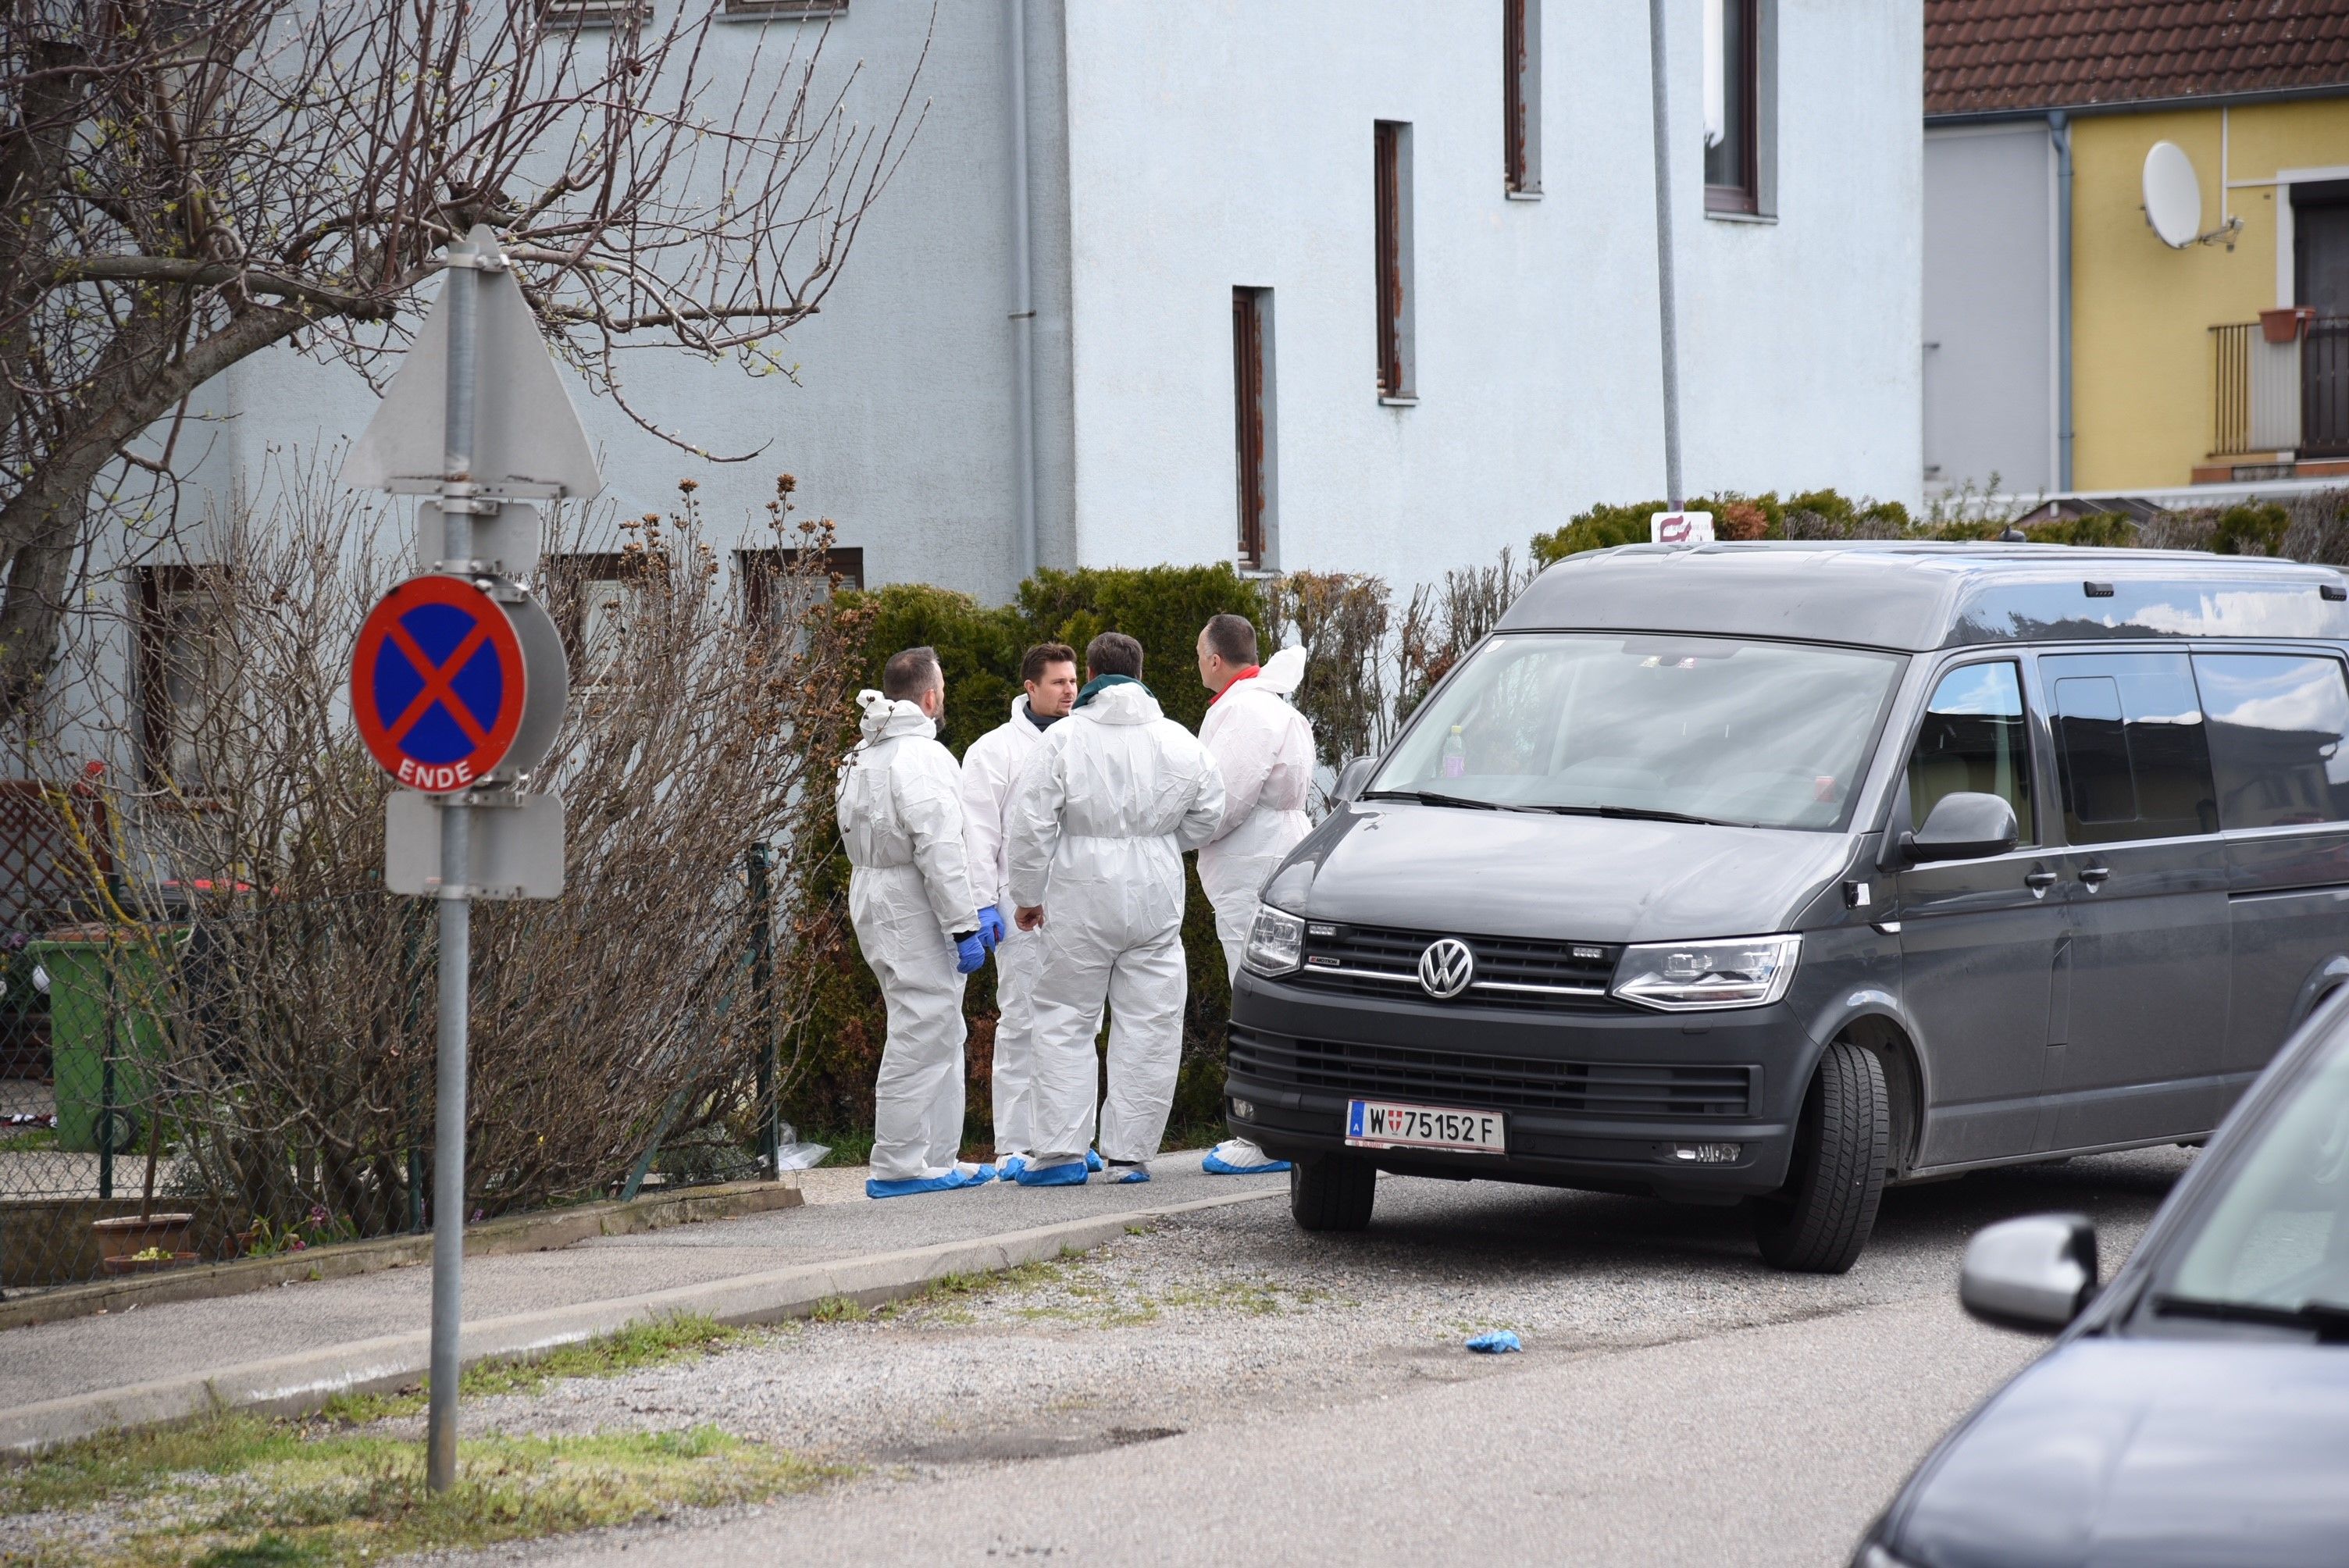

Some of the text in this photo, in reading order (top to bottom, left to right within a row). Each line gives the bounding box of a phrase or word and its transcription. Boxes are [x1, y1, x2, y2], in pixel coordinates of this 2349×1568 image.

[397, 757, 473, 789] ENDE
[1353, 1123, 1360, 1132] A
[1370, 1107, 1494, 1143] W 75152 F
